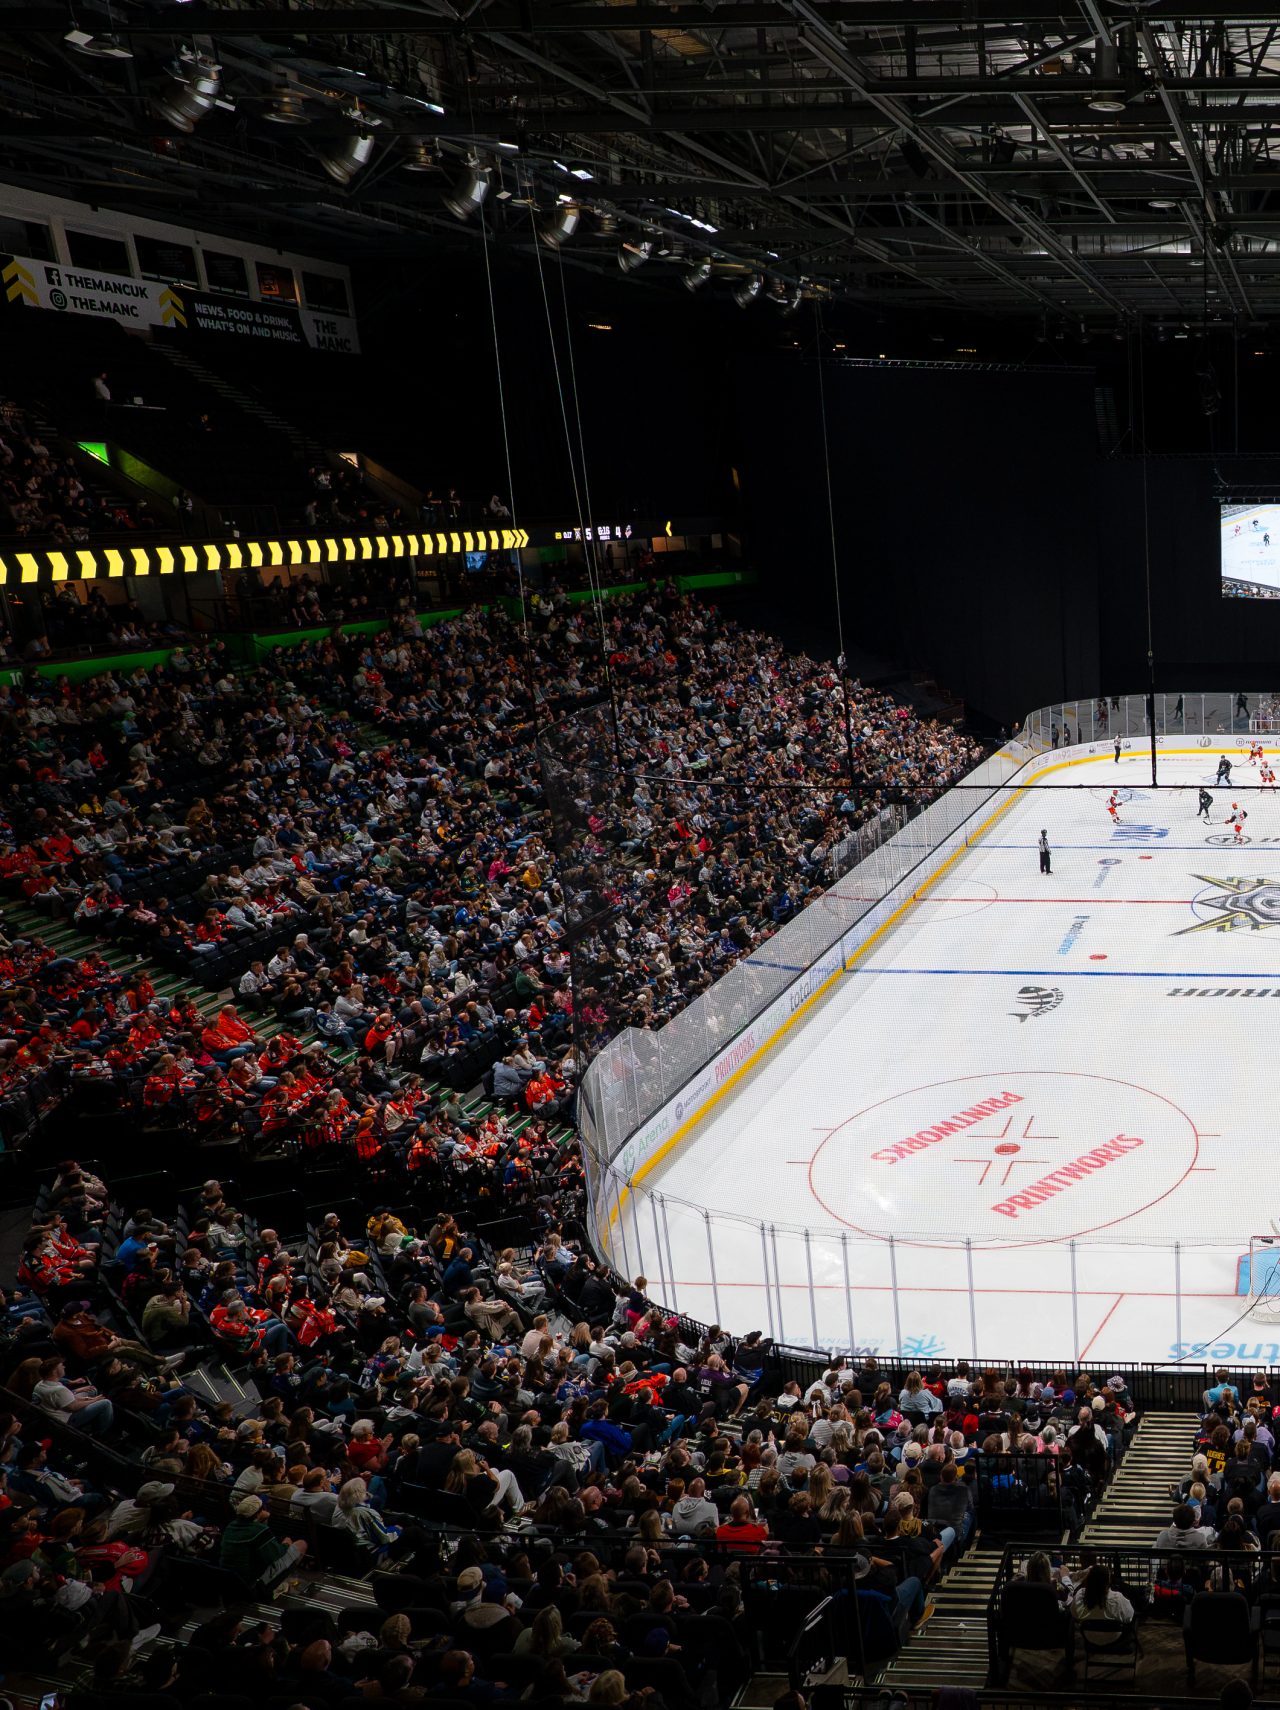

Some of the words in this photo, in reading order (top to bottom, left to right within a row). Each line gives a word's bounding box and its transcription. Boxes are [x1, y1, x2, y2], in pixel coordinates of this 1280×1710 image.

[65, 273, 149, 300] THEMANCUK
[69, 295, 139, 318] THE.MANC
[194, 302, 226, 320] NEWS,
[227, 308, 254, 322] FOOD
[255, 313, 262, 324] &
[262, 314, 293, 330] DRINK,
[196, 317, 235, 334] WHAT'S
[236, 324, 251, 335] ON
[252, 326, 271, 339] AND
[272, 329, 301, 343] MUSIC.
[313, 318, 338, 335] THE
[316, 335, 351, 352] MANC
[585, 527, 593, 540] 5
[615, 526, 622, 538] 4
[870, 1090, 1026, 1166] PRINTWORKS
[989, 1132, 1145, 1219] PRINTWORKS
